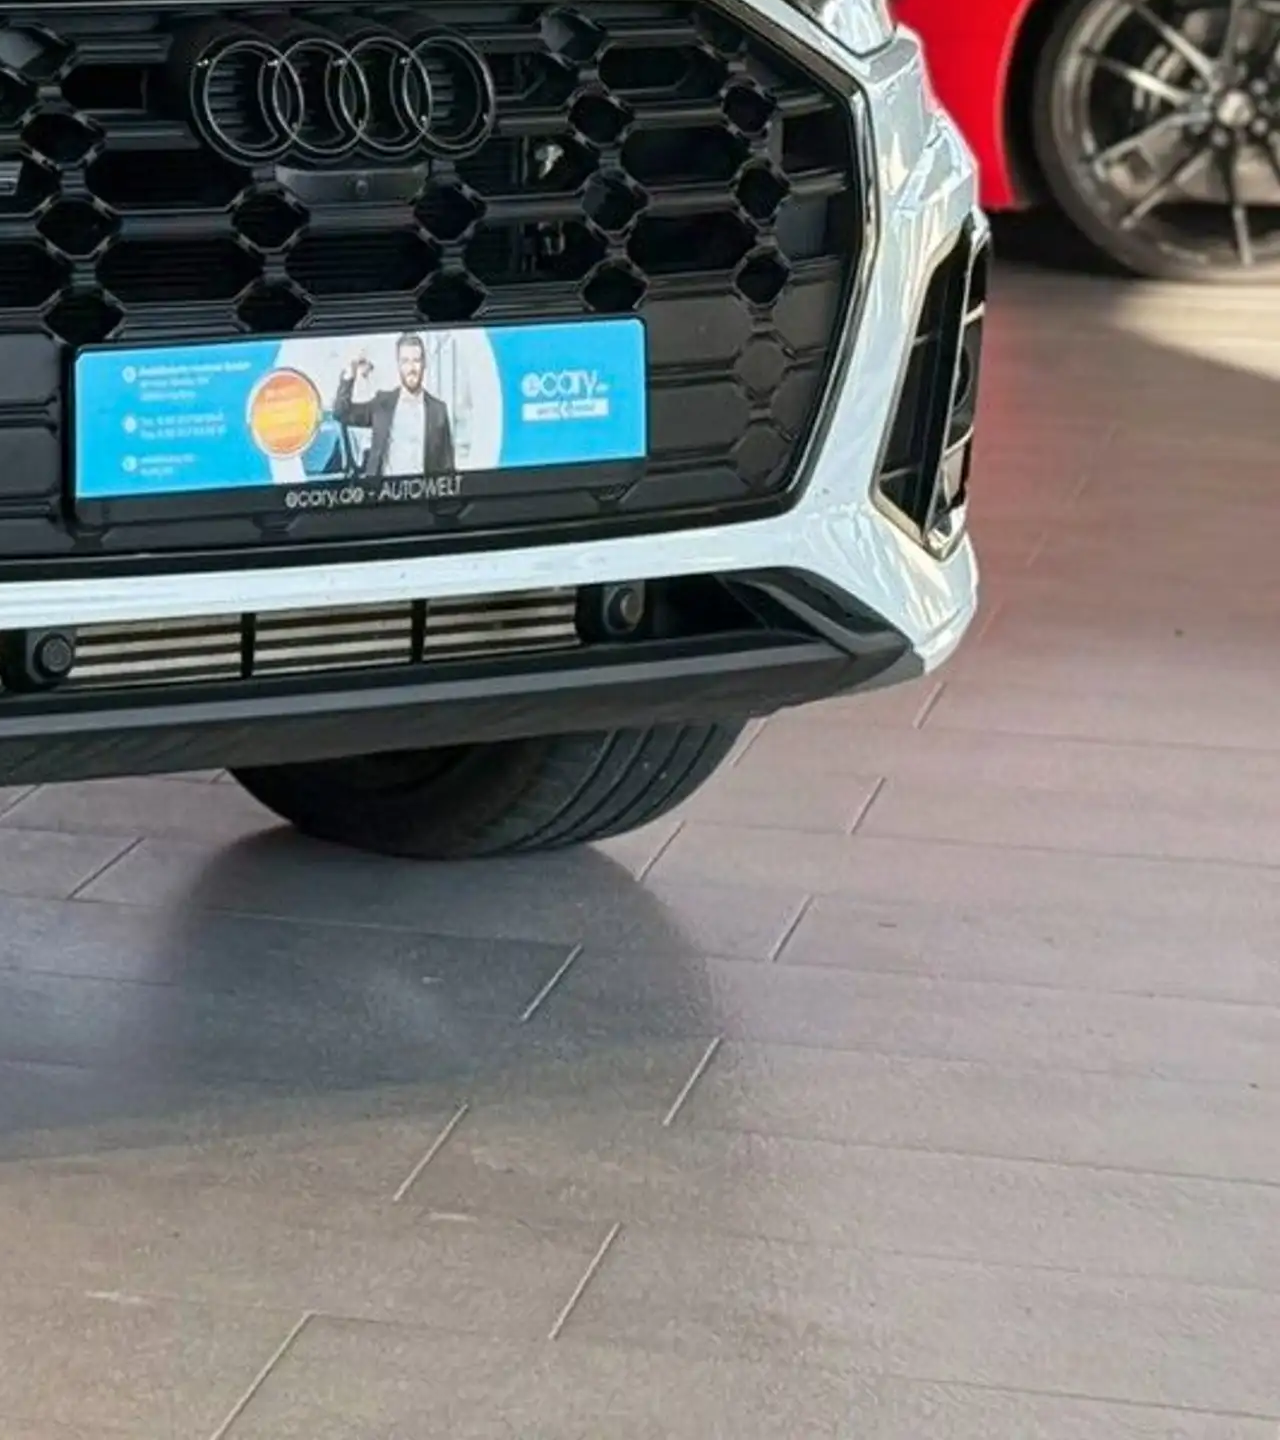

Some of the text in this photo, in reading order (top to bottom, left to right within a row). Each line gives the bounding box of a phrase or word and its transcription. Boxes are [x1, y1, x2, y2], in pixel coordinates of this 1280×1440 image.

[521, 368, 610, 398] ecary
[285, 486, 365, 509] ecary.de
[377, 475, 463, 501] AUTOWELT
